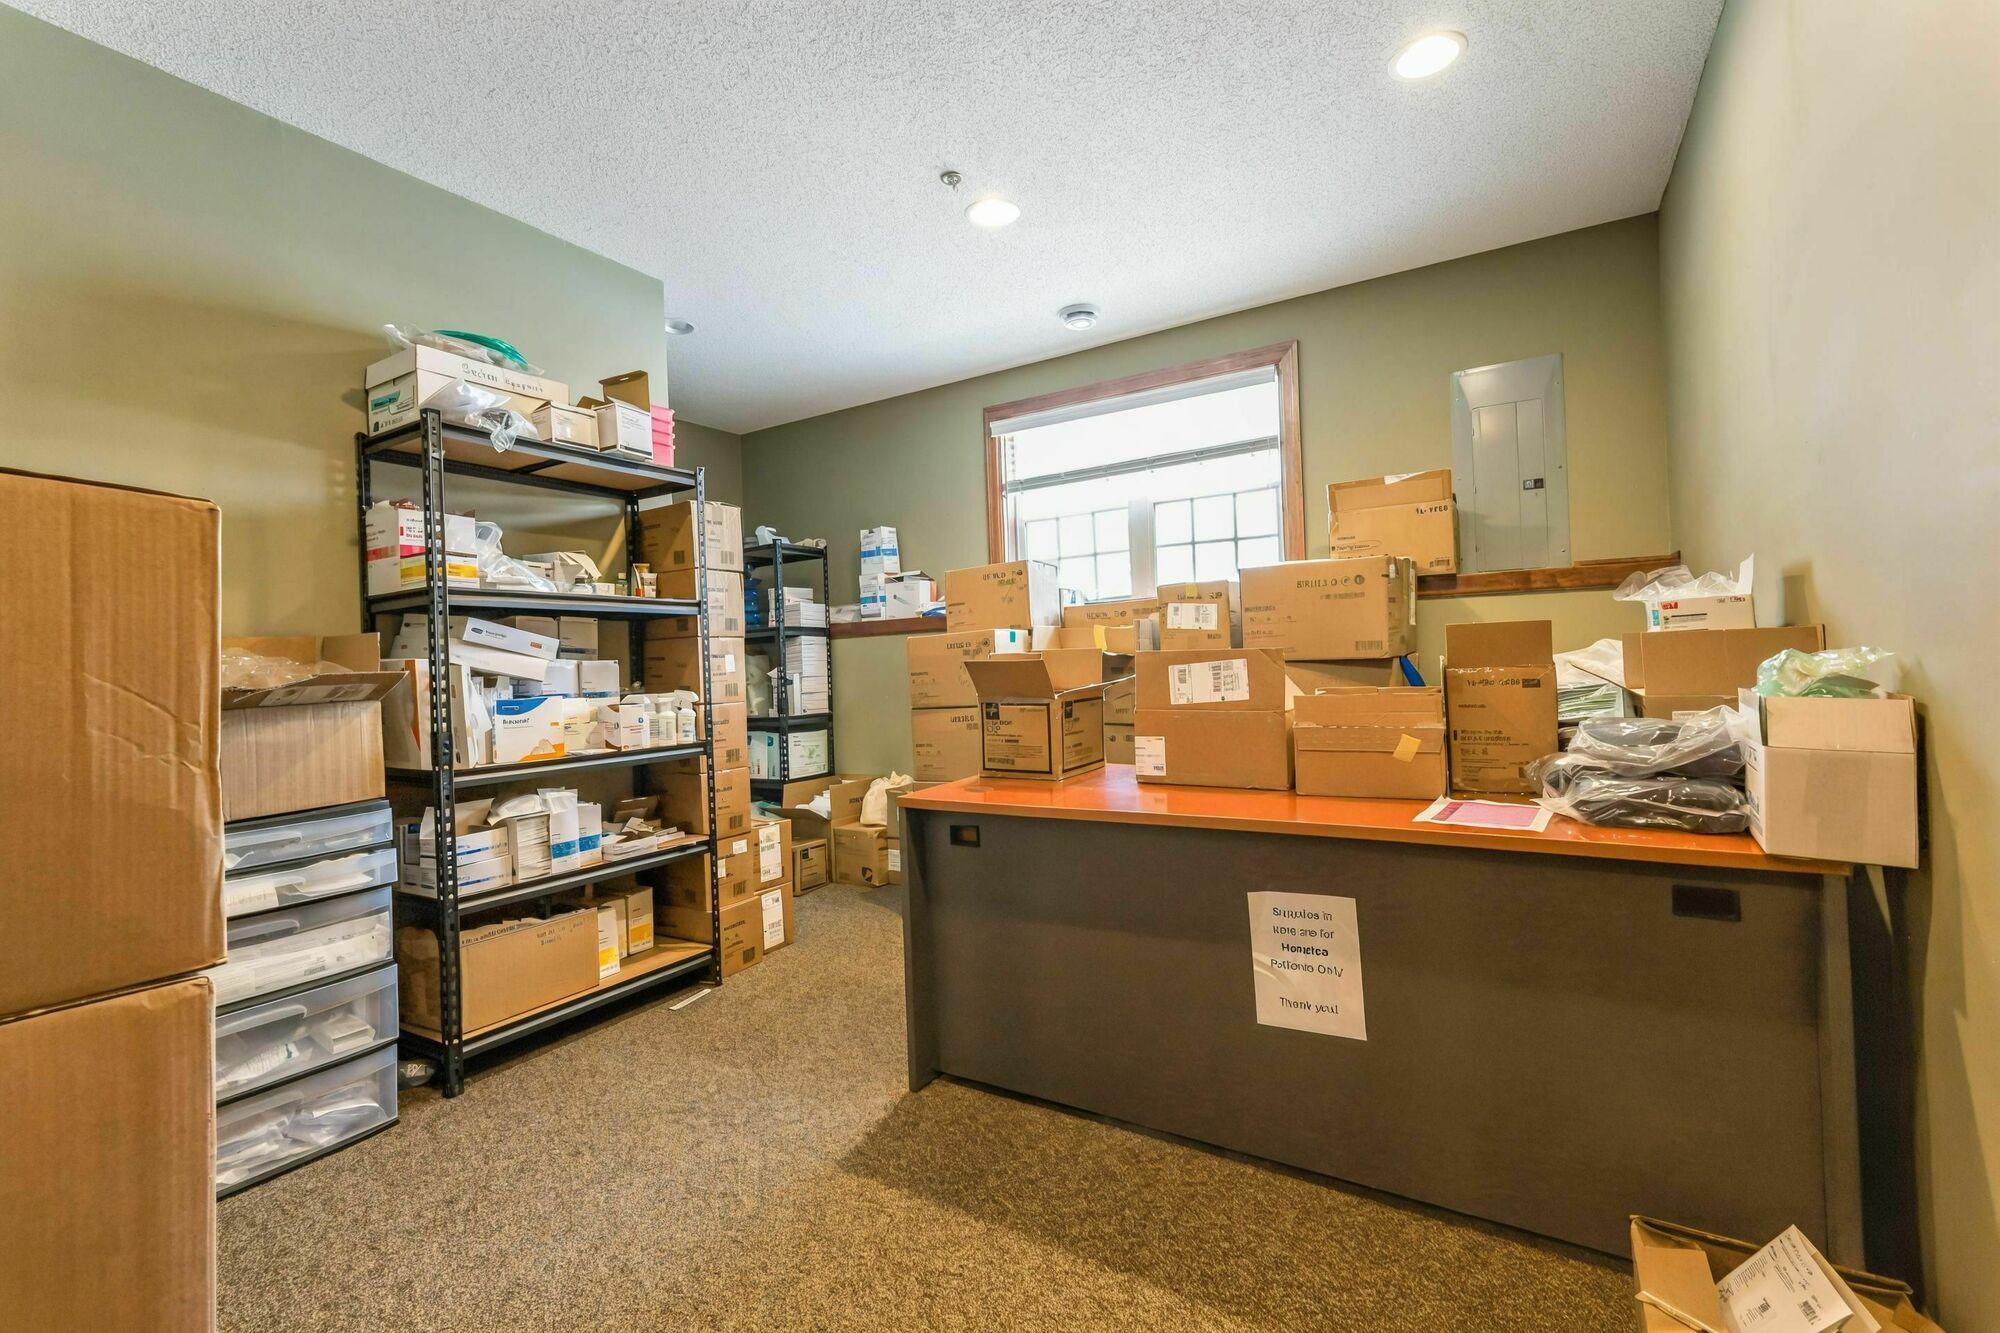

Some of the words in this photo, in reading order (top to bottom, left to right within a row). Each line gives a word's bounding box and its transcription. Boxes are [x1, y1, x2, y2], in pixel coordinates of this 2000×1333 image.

[1322, 910, 1333, 921] in
[1299, 928, 1318, 938] are
[1320, 929, 1335, 939] for
[1317, 964, 1344, 978] Only
[1279, 996, 1312, 1011] Thank
